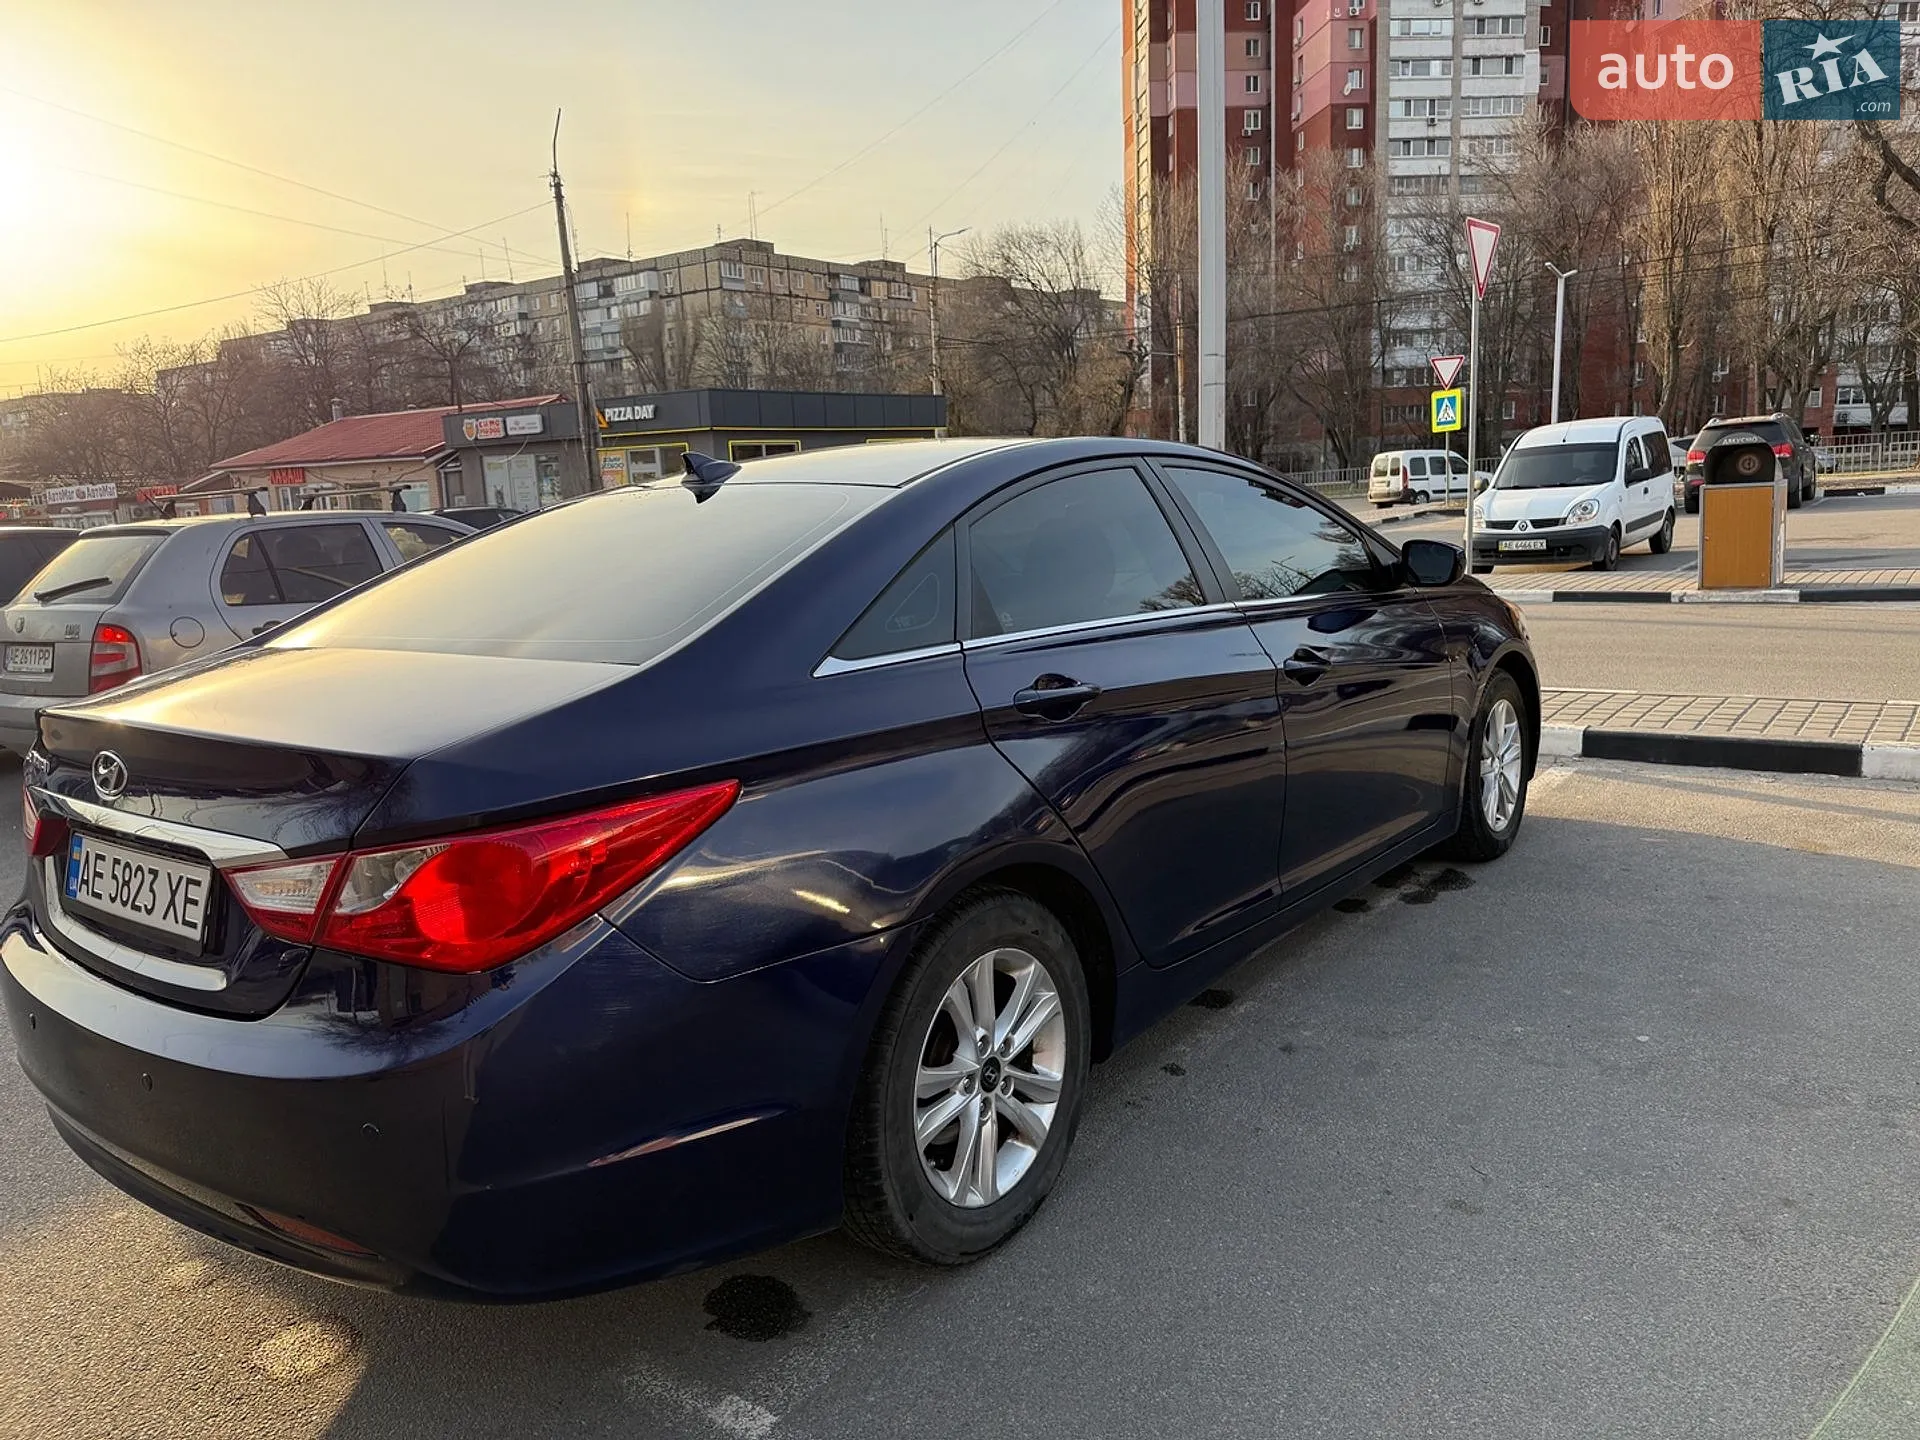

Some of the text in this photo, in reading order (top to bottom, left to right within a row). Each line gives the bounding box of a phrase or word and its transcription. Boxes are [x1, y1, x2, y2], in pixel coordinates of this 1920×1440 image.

[604, 404, 656, 422] PIZZA DAY
[78, 849, 203, 930] AE 5823 XE
